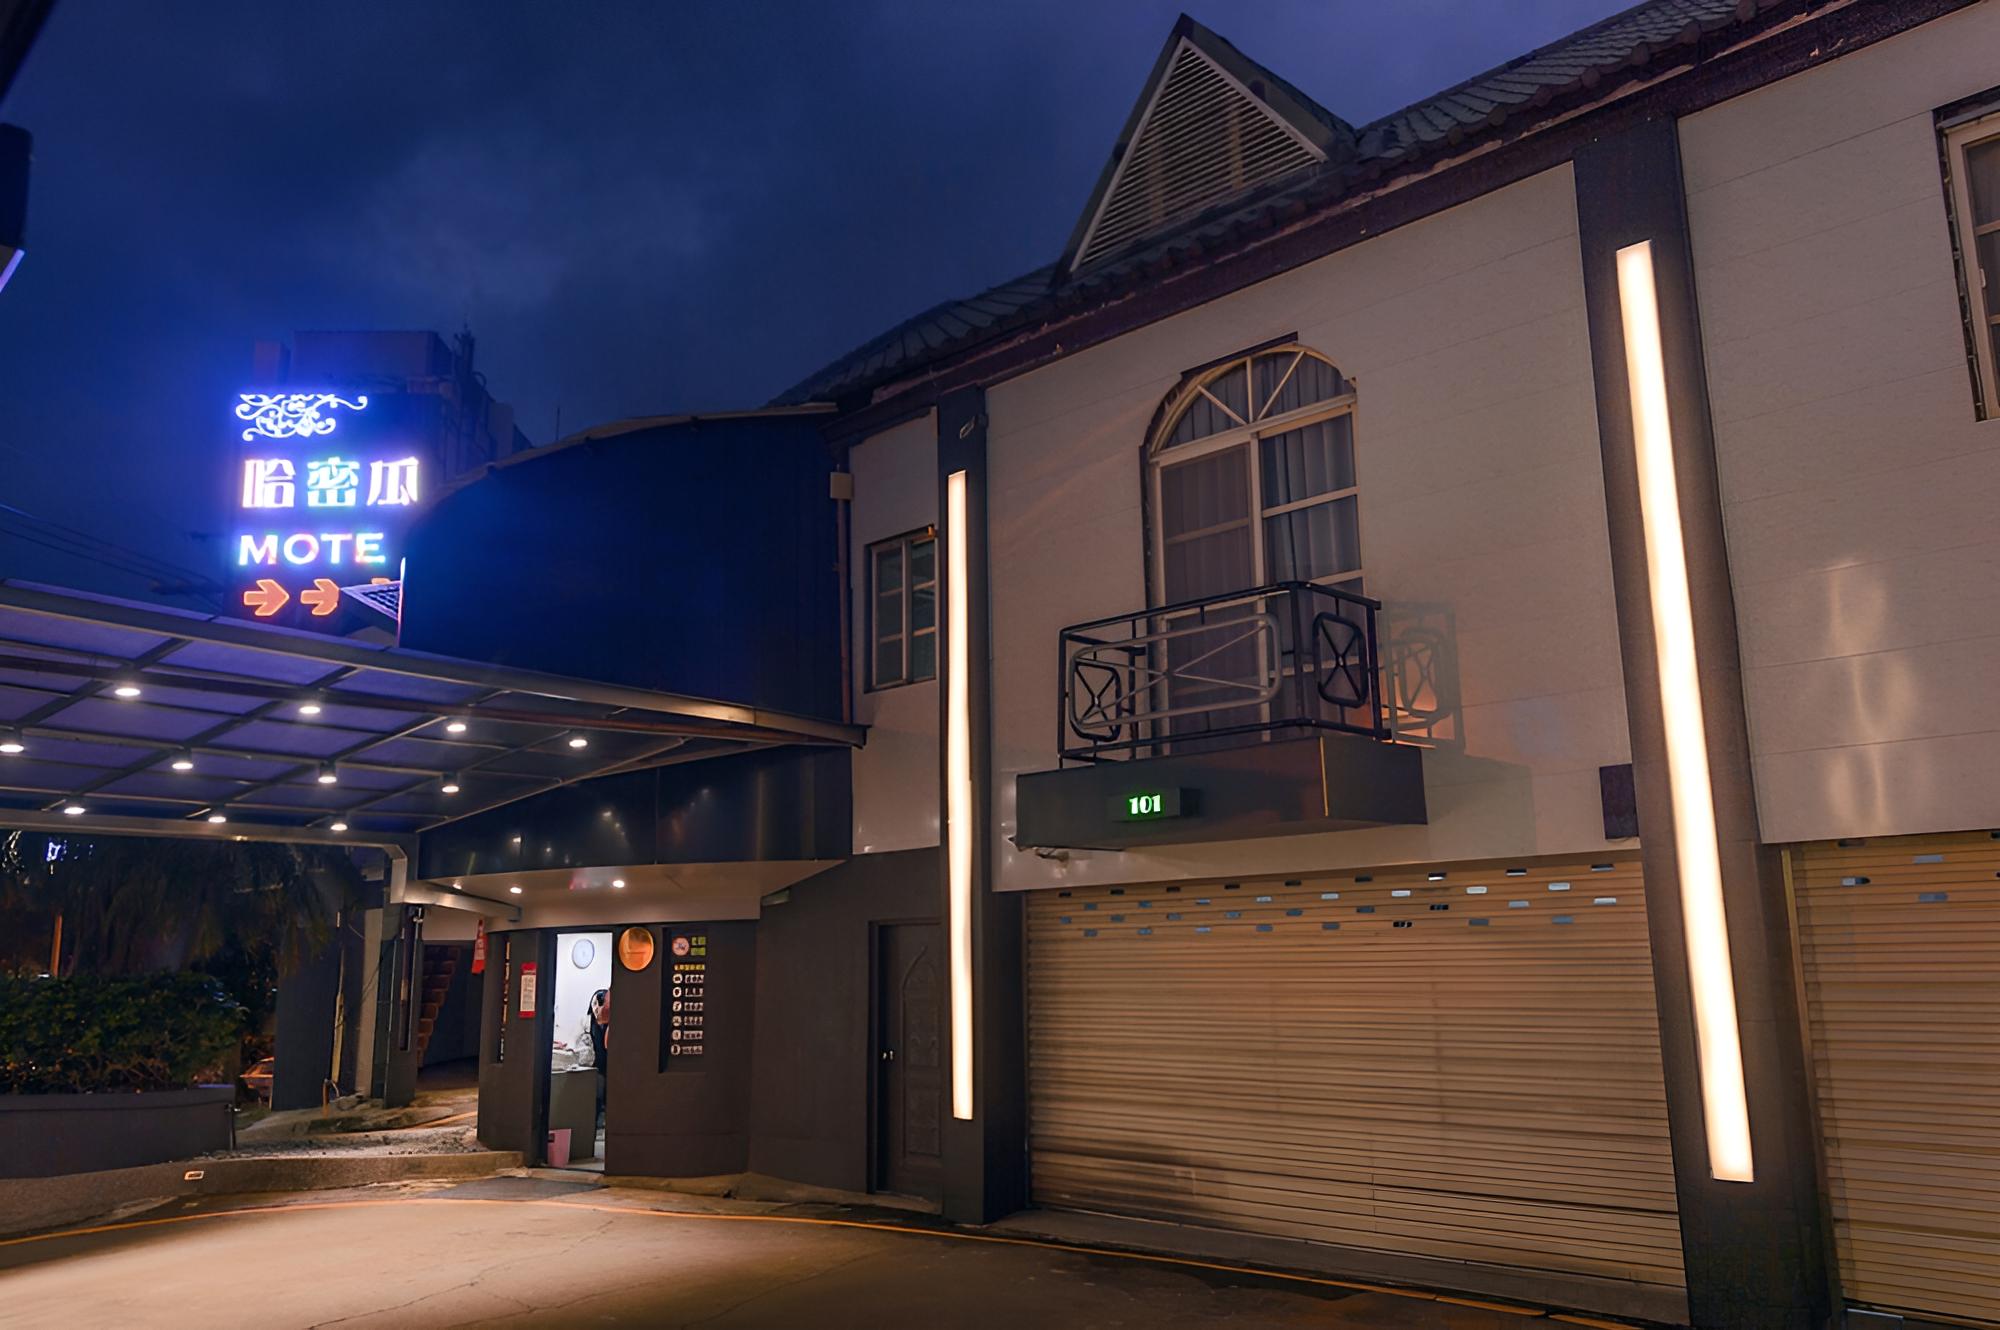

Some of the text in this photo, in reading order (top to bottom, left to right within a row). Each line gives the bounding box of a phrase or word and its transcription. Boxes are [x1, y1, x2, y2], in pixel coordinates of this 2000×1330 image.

[241, 456, 420, 509] 哈密瓜
[238, 532, 387, 566] MOTE
[1128, 794, 1161, 815] 101
